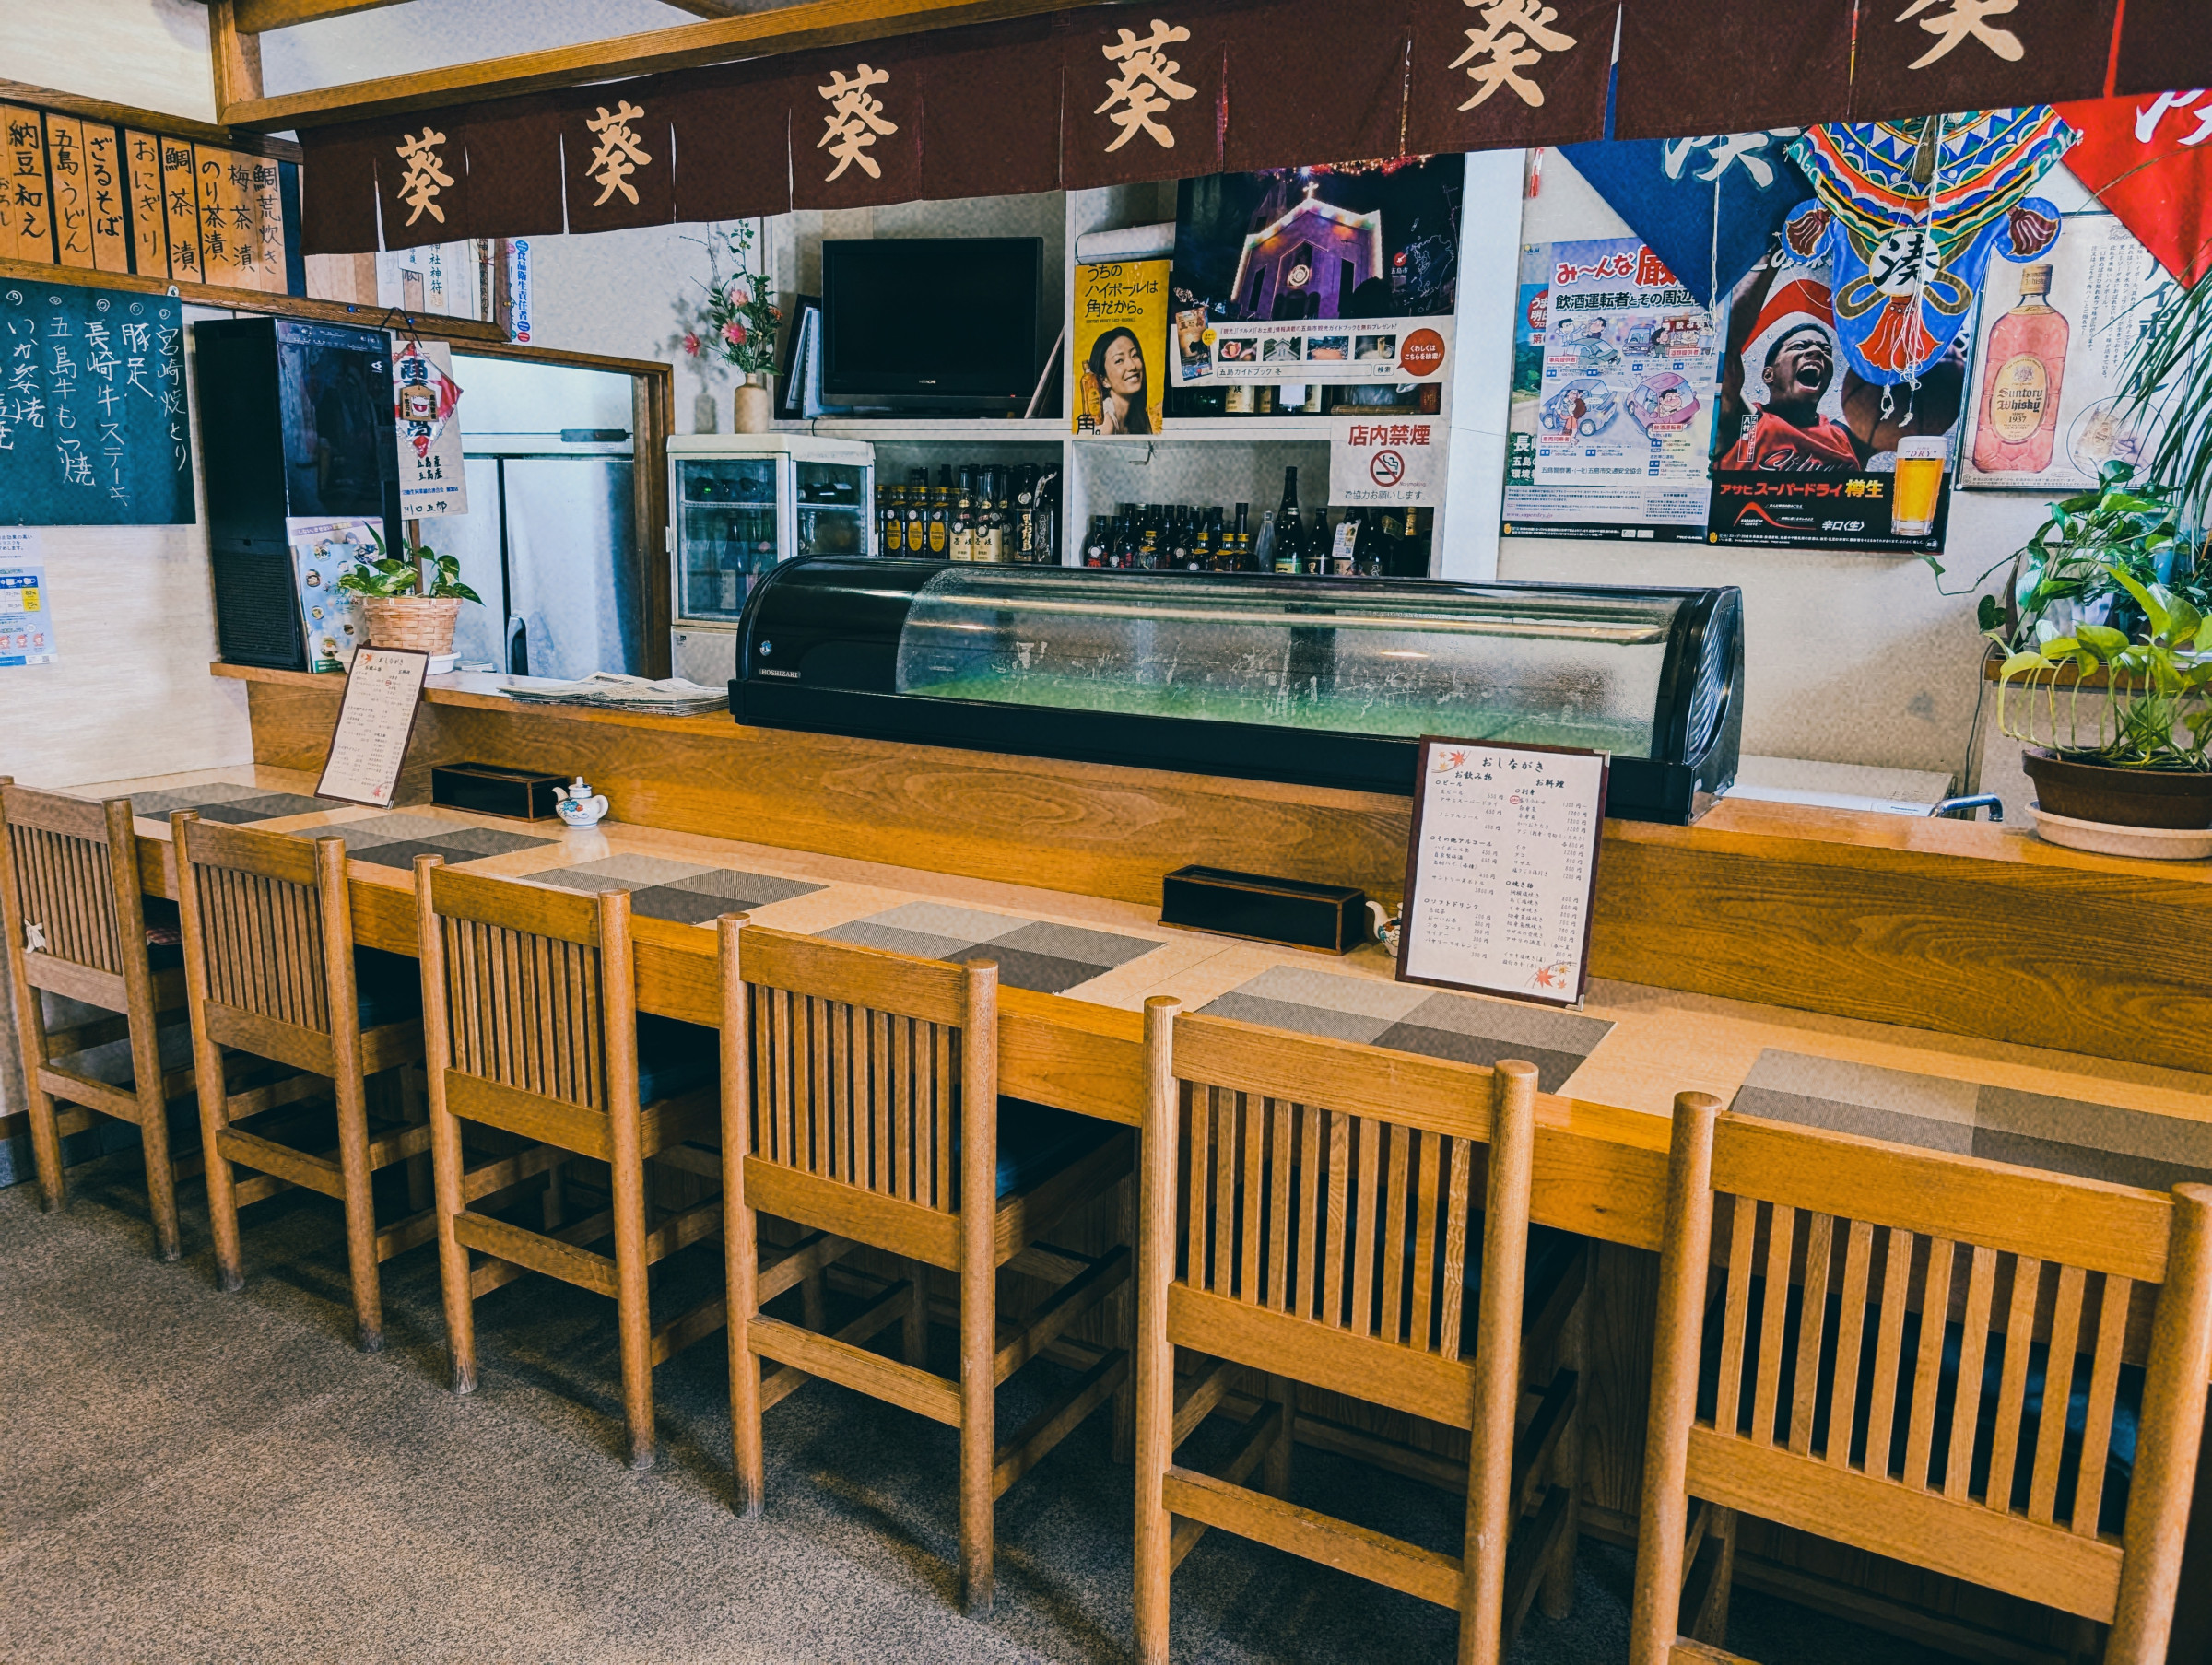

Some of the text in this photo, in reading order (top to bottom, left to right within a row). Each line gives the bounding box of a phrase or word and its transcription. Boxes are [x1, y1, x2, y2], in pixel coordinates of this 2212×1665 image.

[1094, 18, 1197, 153] 葵
[816, 63, 900, 183] 葵
[585, 100, 653, 206] 葵
[8, 120, 46, 239] 納豆和え
[50, 128, 89, 253] 五島うどん
[90, 137, 123, 237] ざるそば
[133, 139, 160, 257] おにぎり
[395, 126, 455, 227] 葵
[165, 147, 199, 273] 鯛茶漬
[201, 160, 229, 263] のり茶漬
[227, 164, 255, 273] 梅茶漬
[517, 252, 529, 321] 食品衛生責任者
[1085, 280, 1159, 299] ハイボールは
[1088, 264, 1123, 282] うちの
[1085, 299, 1144, 318] 角だから。
[1555, 289, 1700, 311] 飲酒運転者とその周辺
[121, 322, 154, 398] 豚足
[1532, 334, 1546, 344] 第
[8, 318, 45, 428] いか姿焼
[1219, 368, 1272, 376] 五島ガイドブック
[1996, 387, 2043, 401] Suntory
[47, 317, 96, 487] 五島牛もつ焼
[84, 318, 130, 507] 長崎牛ステーキ
[156, 324, 187, 472] 宮崎焼とり
[1996, 398, 2042, 413] Whisky
[1076, 414, 1100, 435] 角。
[1347, 424, 1431, 447] 店内禁煙
[1345, 490, 1427, 501] ご協力お願いします。
[1511, 468, 1535, 479] 環境
[1845, 478, 1884, 498] 樽生
[760, 668, 799, 678] HOSHIZAKI
[1454, 770, 1493, 781] お飲み物
[1482, 756, 1544, 773] おしながき
[1535, 778, 1565, 789] お料理
